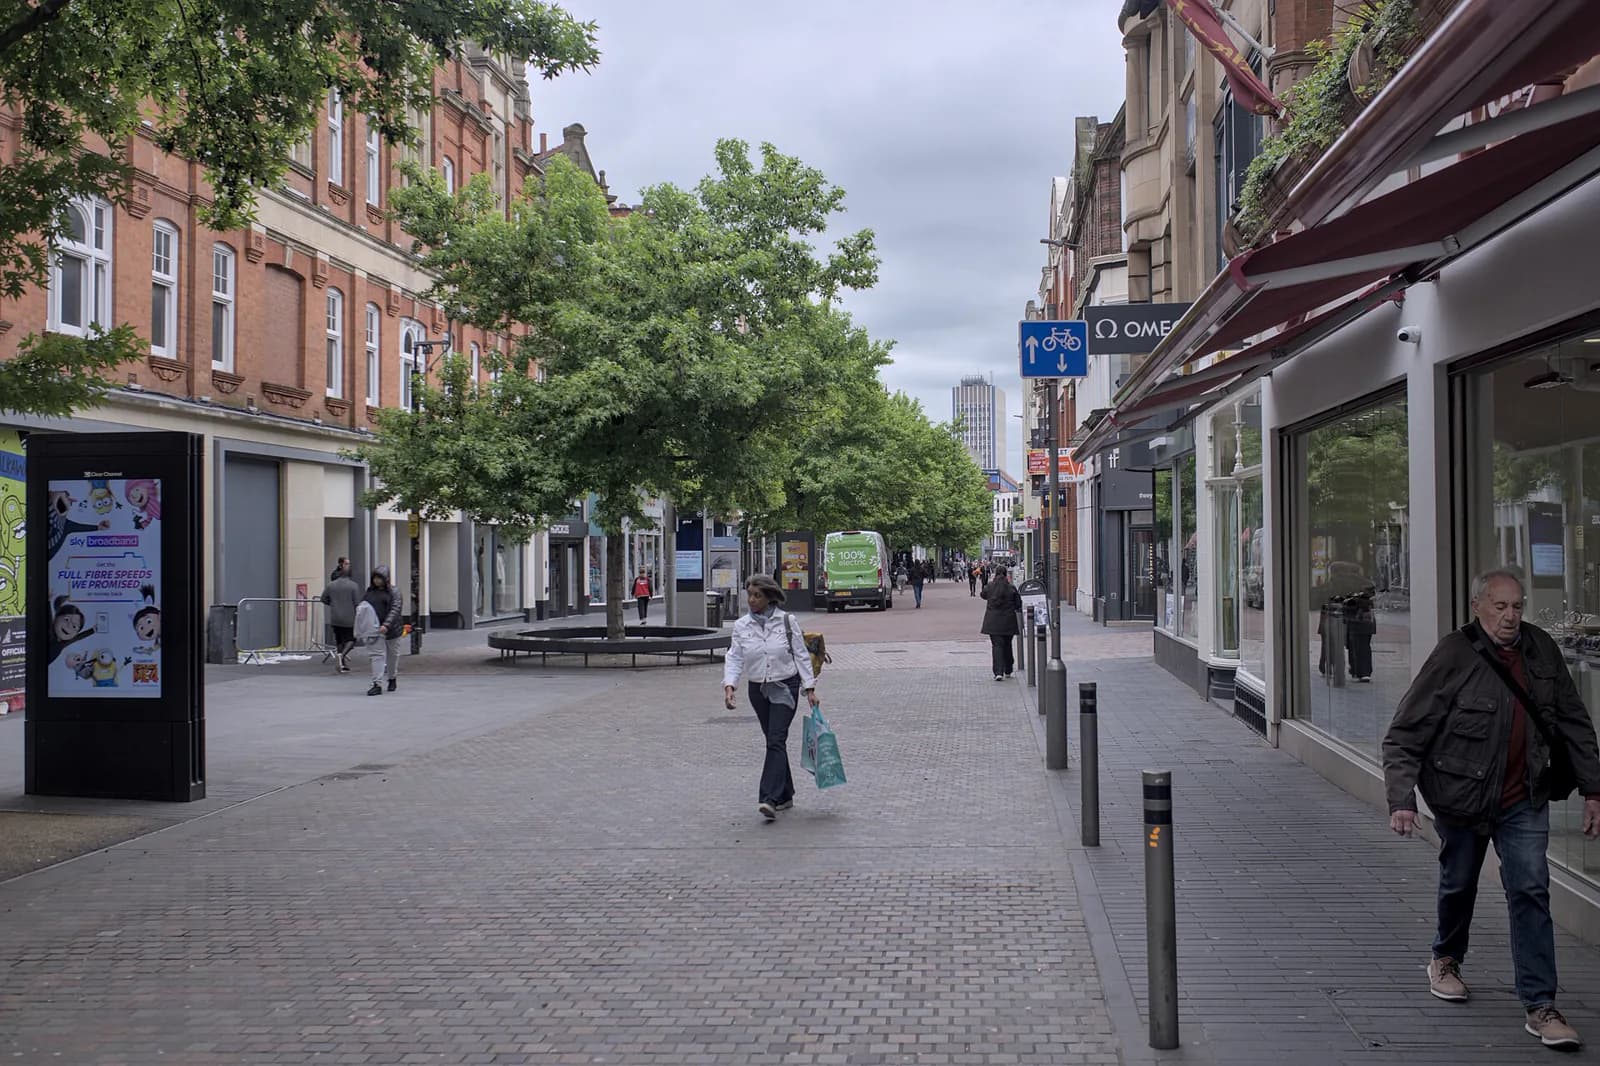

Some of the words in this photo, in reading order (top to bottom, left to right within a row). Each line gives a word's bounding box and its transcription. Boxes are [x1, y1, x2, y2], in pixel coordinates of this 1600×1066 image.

[1124, 320, 1180, 338] OME
[70, 536, 86, 547] sky
[88, 536, 137, 546] broadband
[839, 550, 866, 560] 100%
[839, 559, 866, 567] electric
[58, 571, 82, 579] FULL
[85, 570, 113, 579] FIBRE
[114, 570, 152, 578] SPEEDS
[72, 580, 86, 589] WE
[88, 580, 140, 589] PROMISED
[2, 647, 26, 656] OFFICIAL
